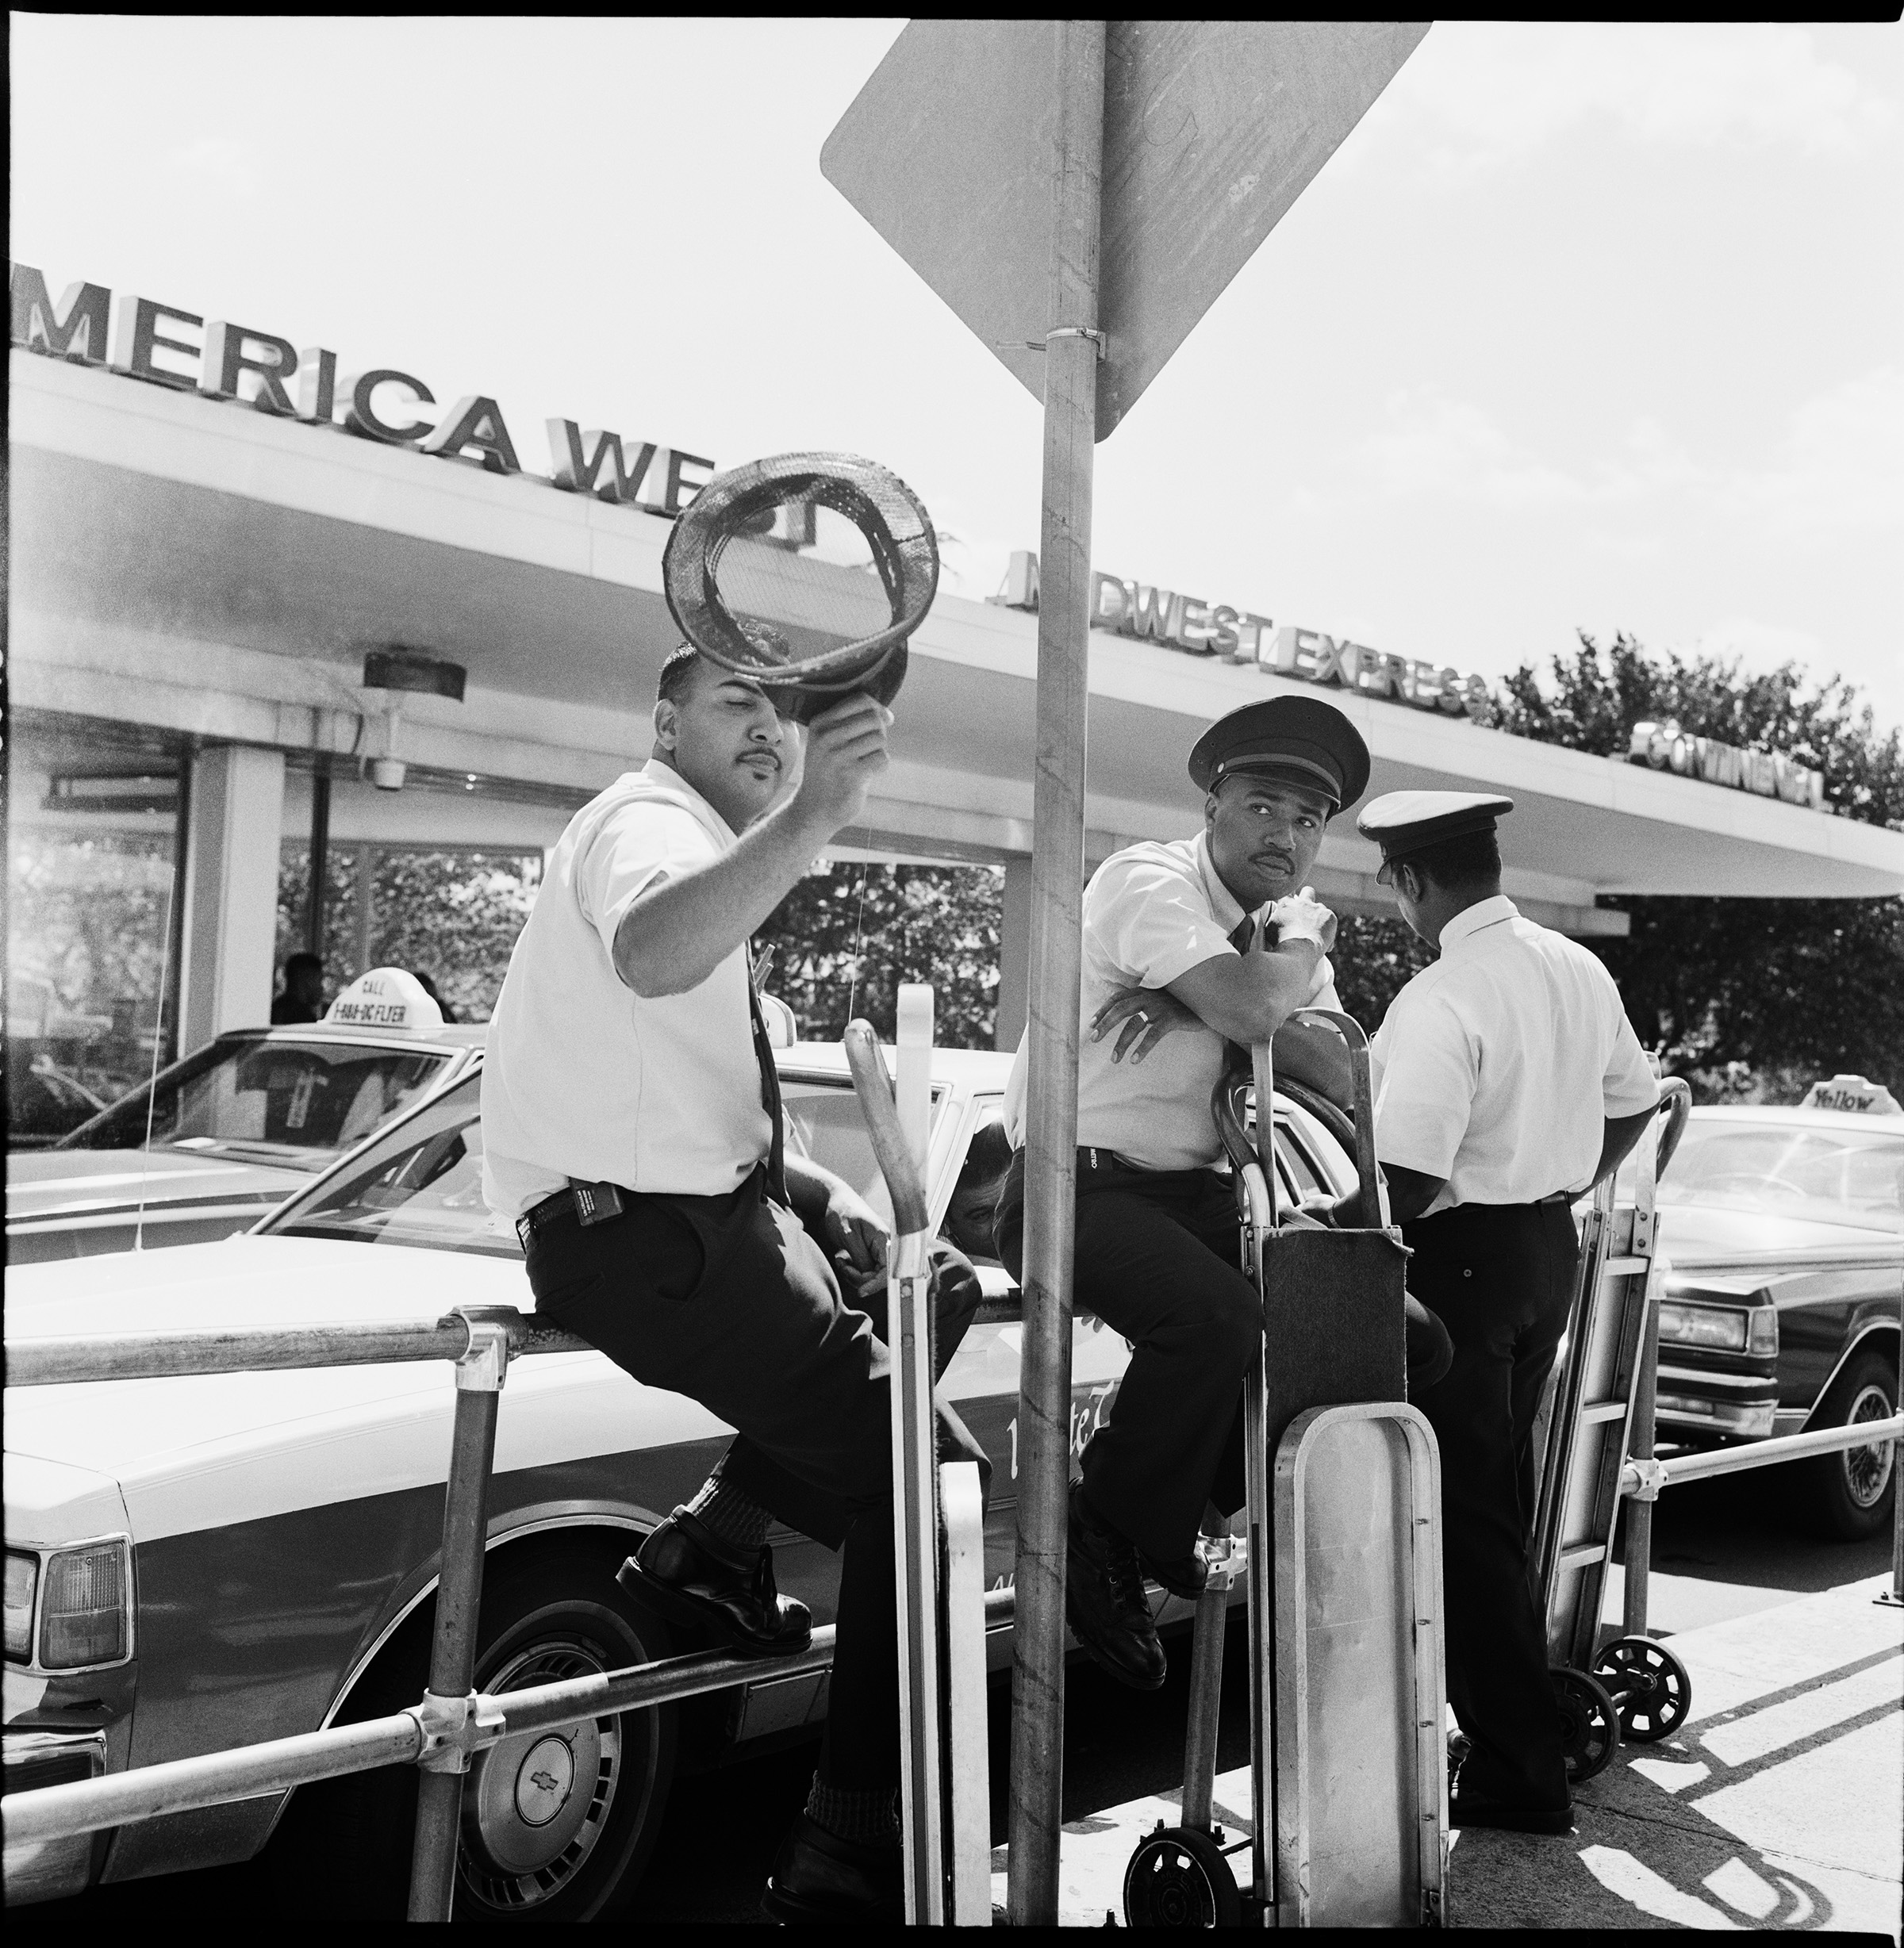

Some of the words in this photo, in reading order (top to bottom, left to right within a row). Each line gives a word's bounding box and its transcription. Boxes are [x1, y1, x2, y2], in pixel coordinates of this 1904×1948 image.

[546, 418, 817, 547] WE
[1010, 550, 1273, 662] DWEST
[363, 980, 385, 995] CALL
[1814, 1089, 1875, 1110] Yellow
